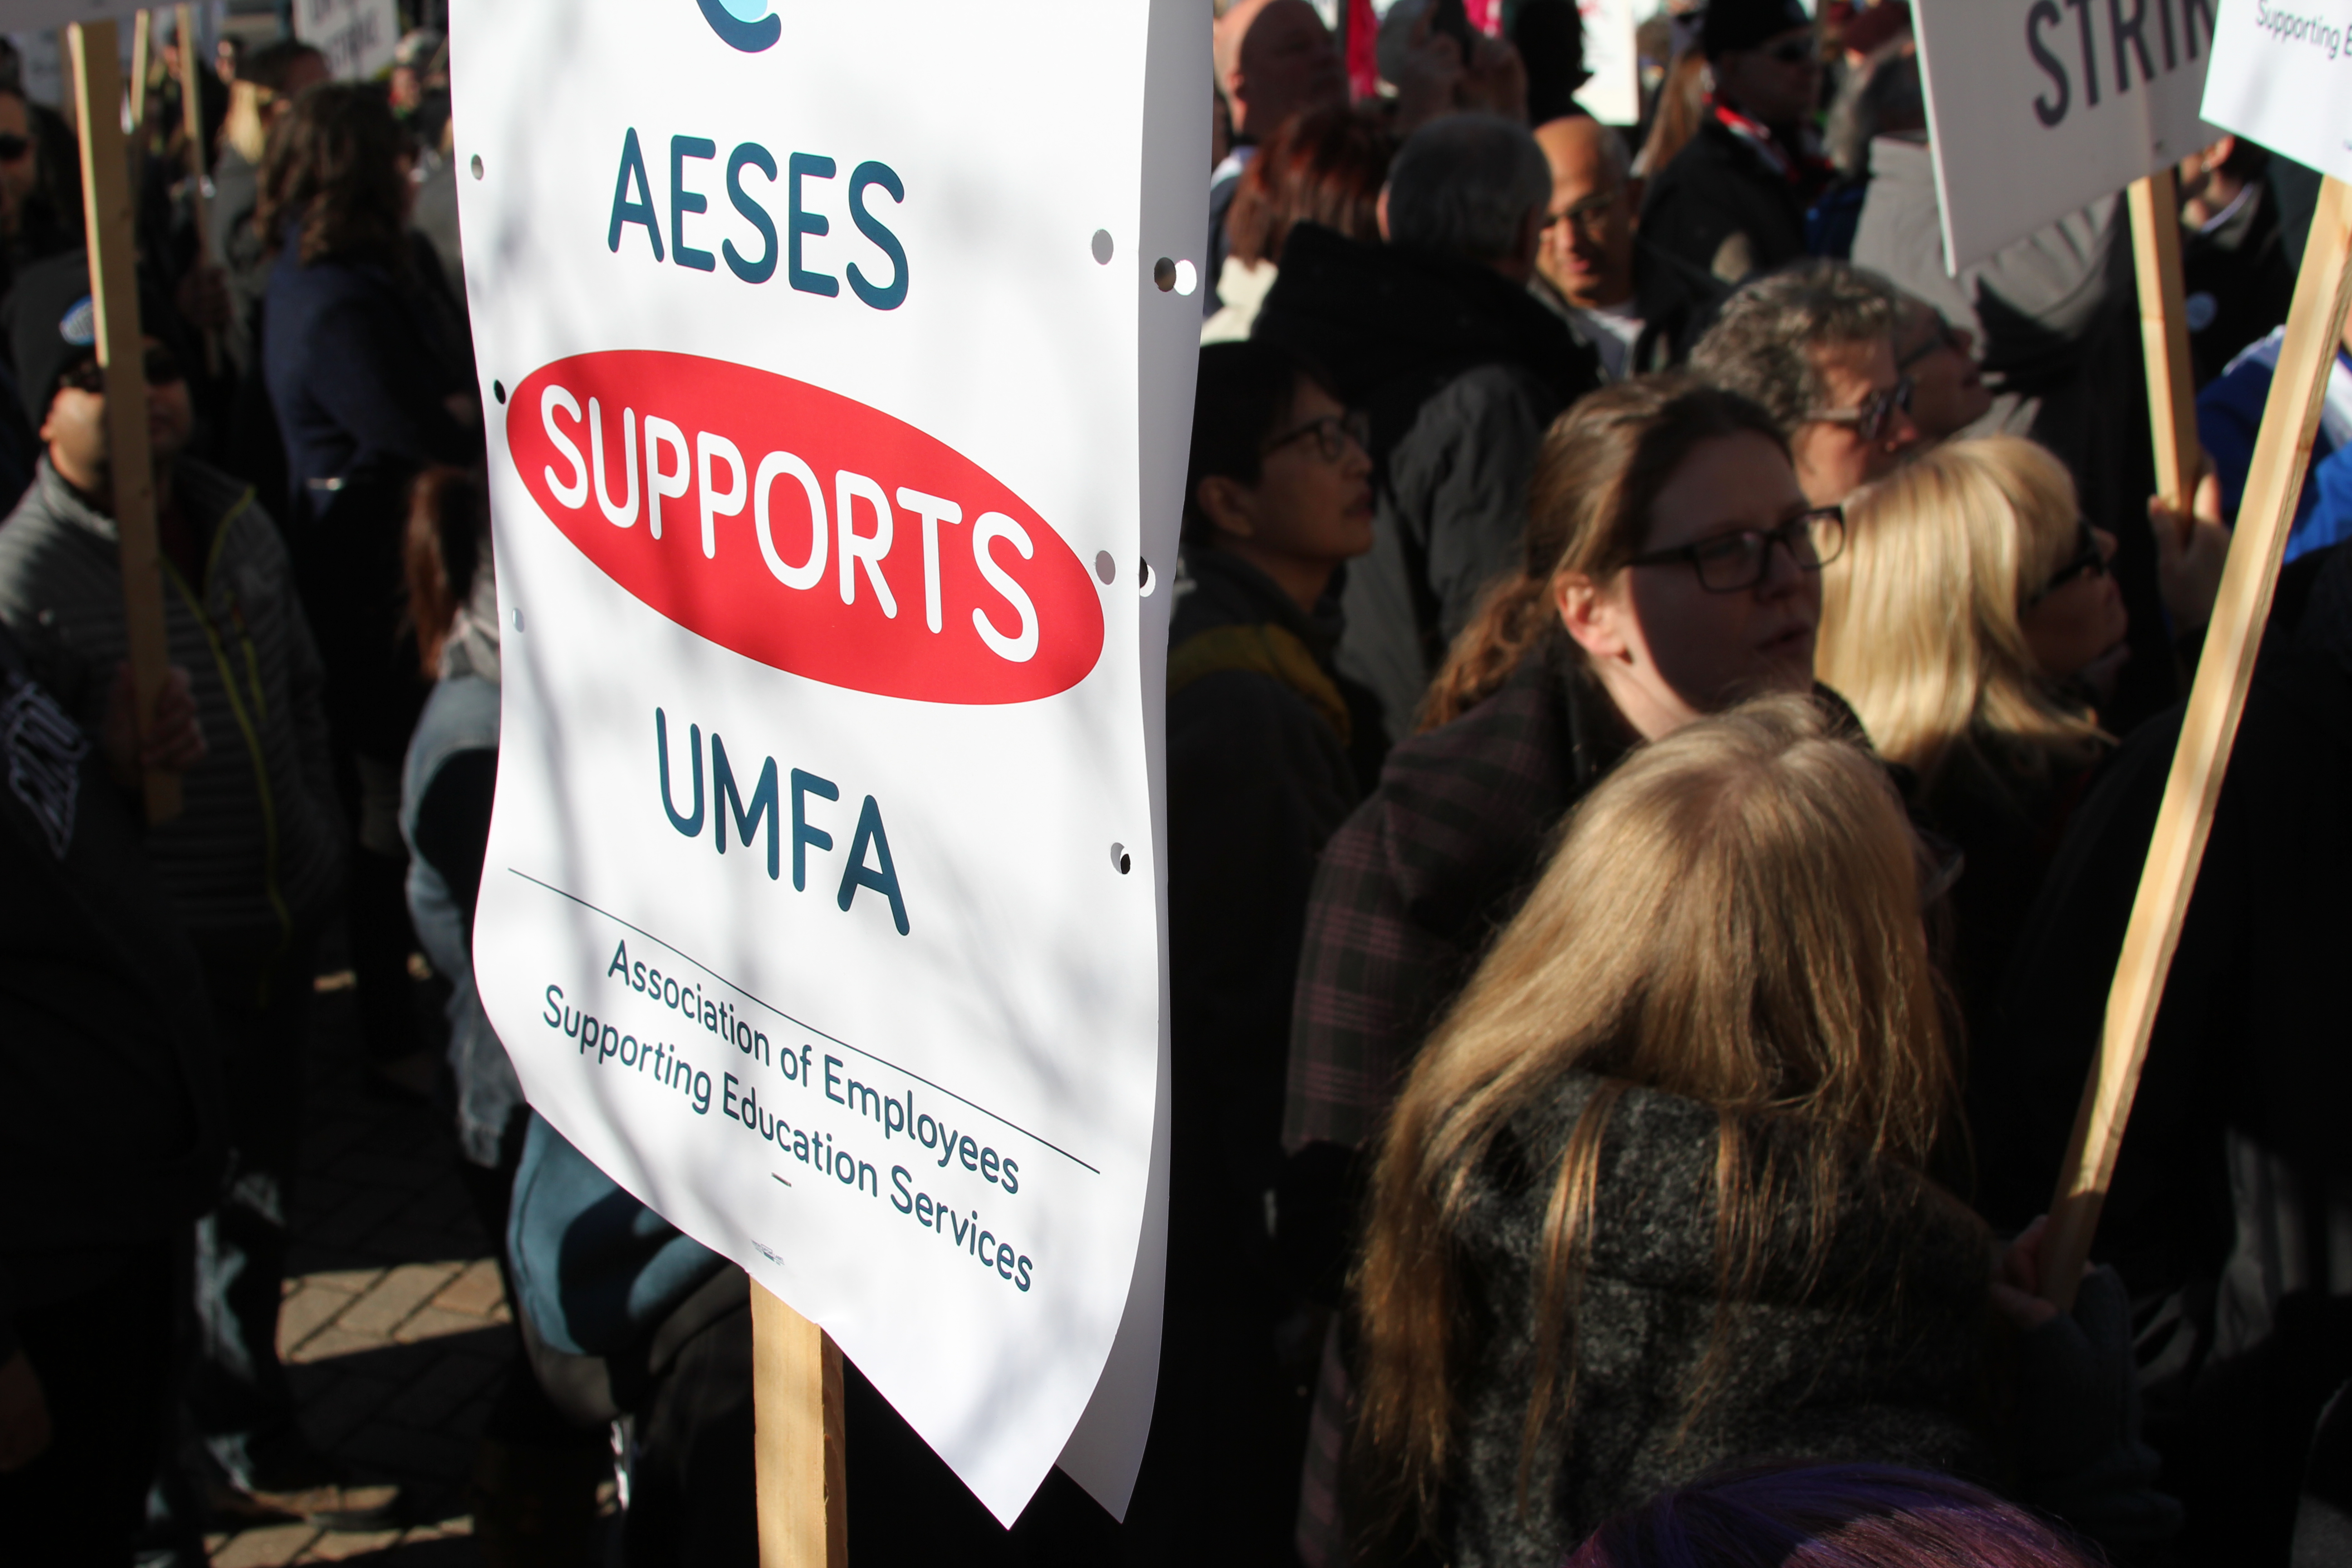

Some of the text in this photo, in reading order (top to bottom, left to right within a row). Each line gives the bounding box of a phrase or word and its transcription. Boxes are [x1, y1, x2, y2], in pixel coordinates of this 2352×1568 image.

[2256, 0, 2340, 60] Supporting
[608, 127, 909, 311] AESES
[540, 384, 1039, 663] SUPPORTS
[656, 707, 910, 936] UMFA
[544, 985, 1033, 1292] Supporting Education Services
[608, 940, 1019, 1194] Association of Employees
